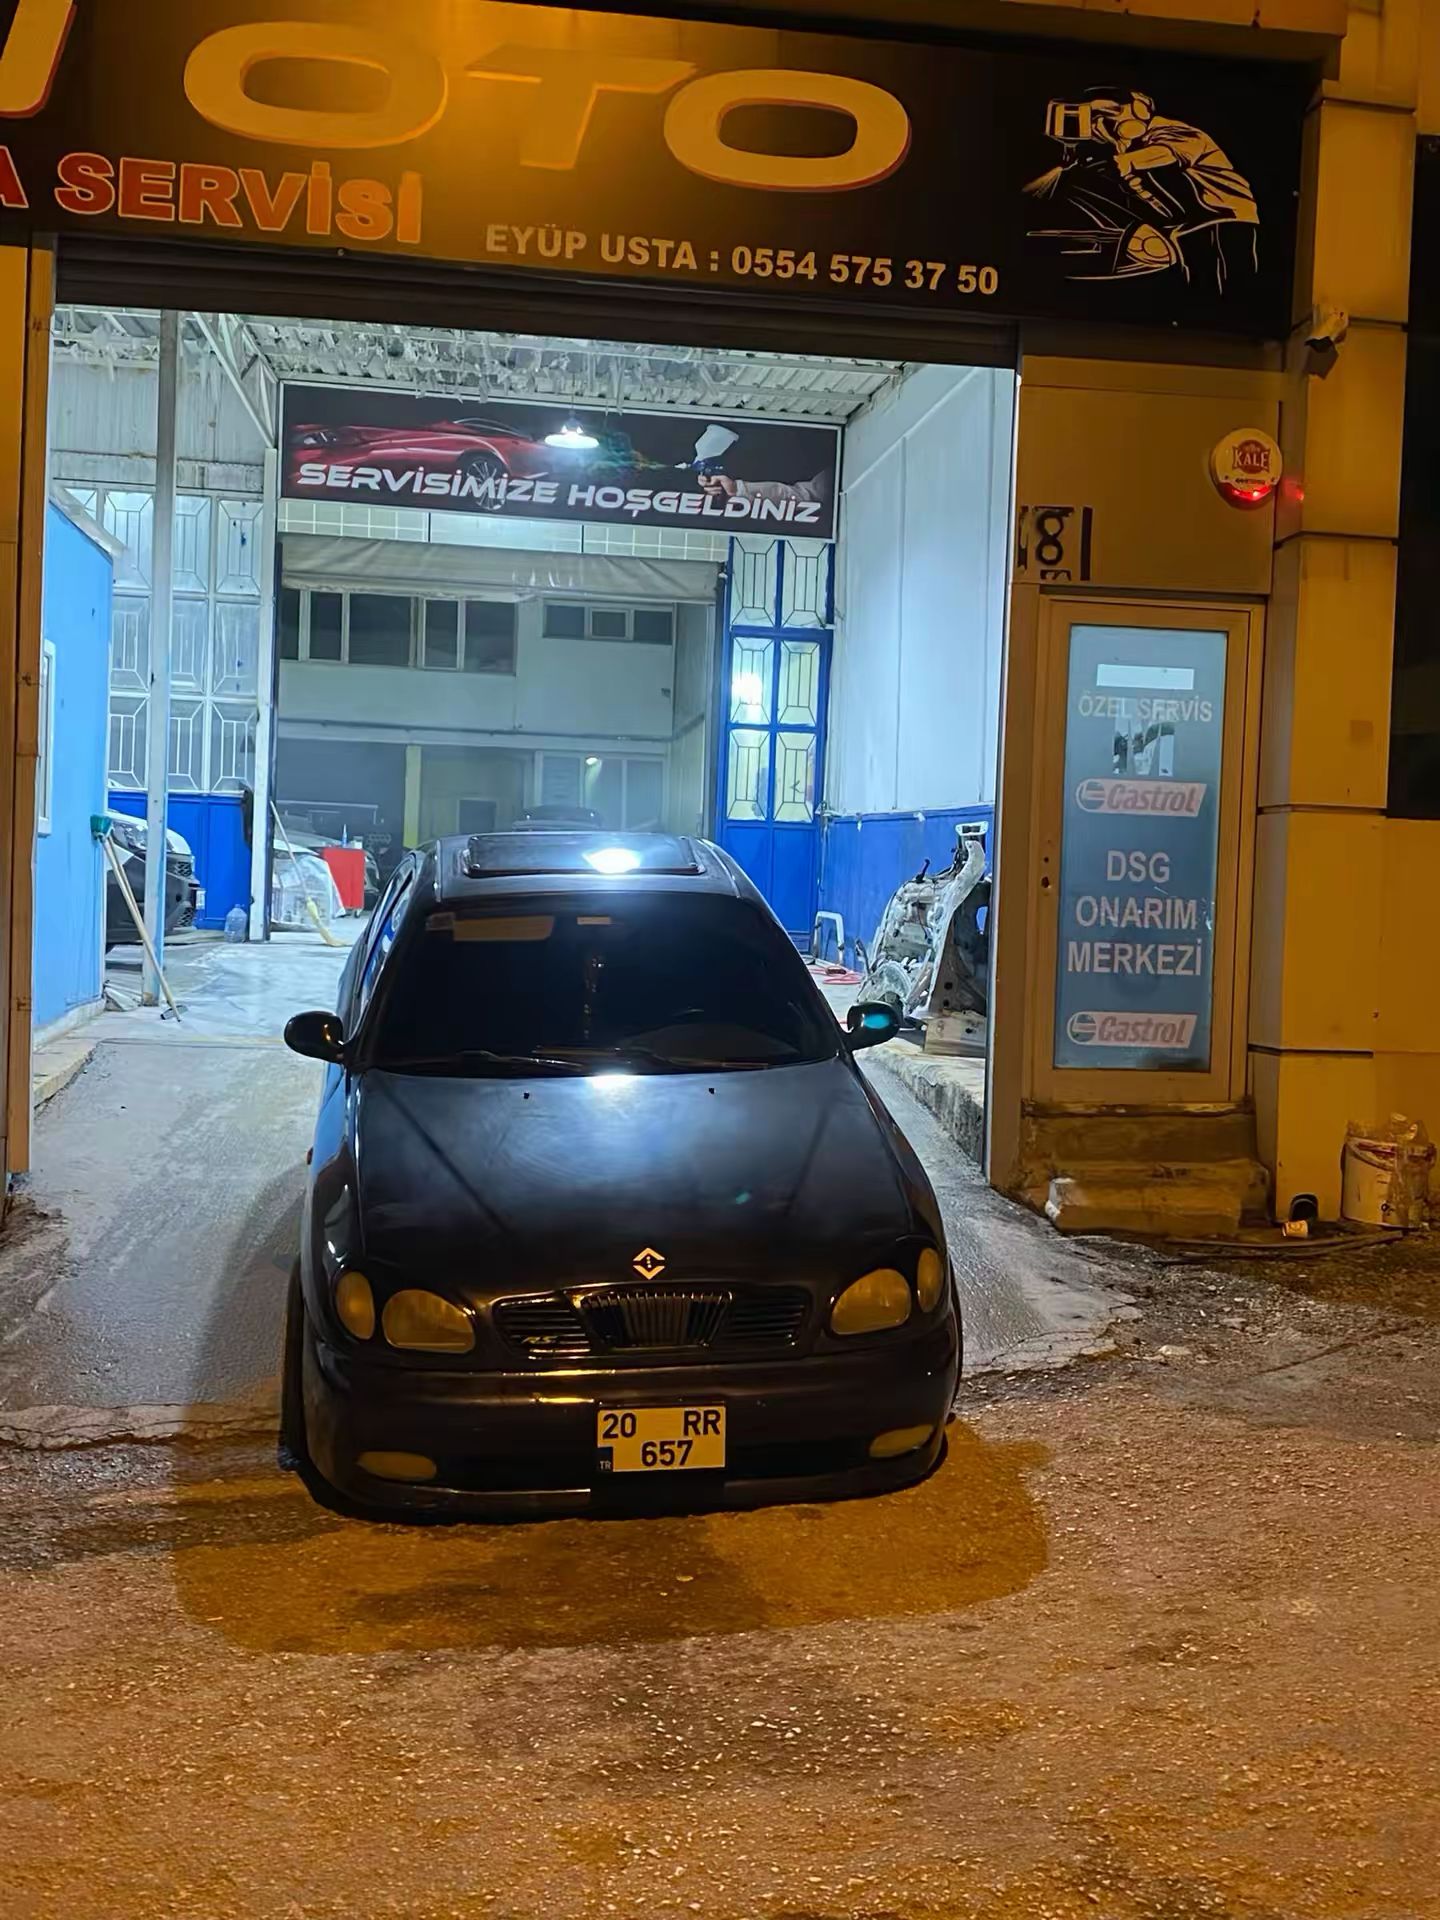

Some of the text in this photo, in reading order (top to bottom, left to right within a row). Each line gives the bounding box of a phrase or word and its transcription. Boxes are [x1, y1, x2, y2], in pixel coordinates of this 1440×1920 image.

[184, 20, 912, 193] OTO
[54, 152, 423, 244] SERVİSİ
[486, 223, 588, 260] EYÜP
[600, 233, 698, 271] USTA
[732, 246, 818, 280] 0554
[829, 254, 893, 286] 575
[904, 260, 947, 291] 37
[956, 265, 999, 295] 50
[1233, 449, 1269, 469] KALE
[297, 463, 822, 524] SERVİSİMİZE HOŞGELDİNİZ
[1078, 690, 1213, 723] ÖZEL SERVİS
[1105, 783, 1198, 813] Castrol
[1107, 850, 1170, 883] DSG
[1075, 895, 1198, 930] ONARIM
[1067, 938, 1203, 976] MERKEZİ
[1099, 1016, 1190, 1044] Castrol
[602, 1409, 721, 1440] 20 RR
[641, 1439, 693, 1467] 657
